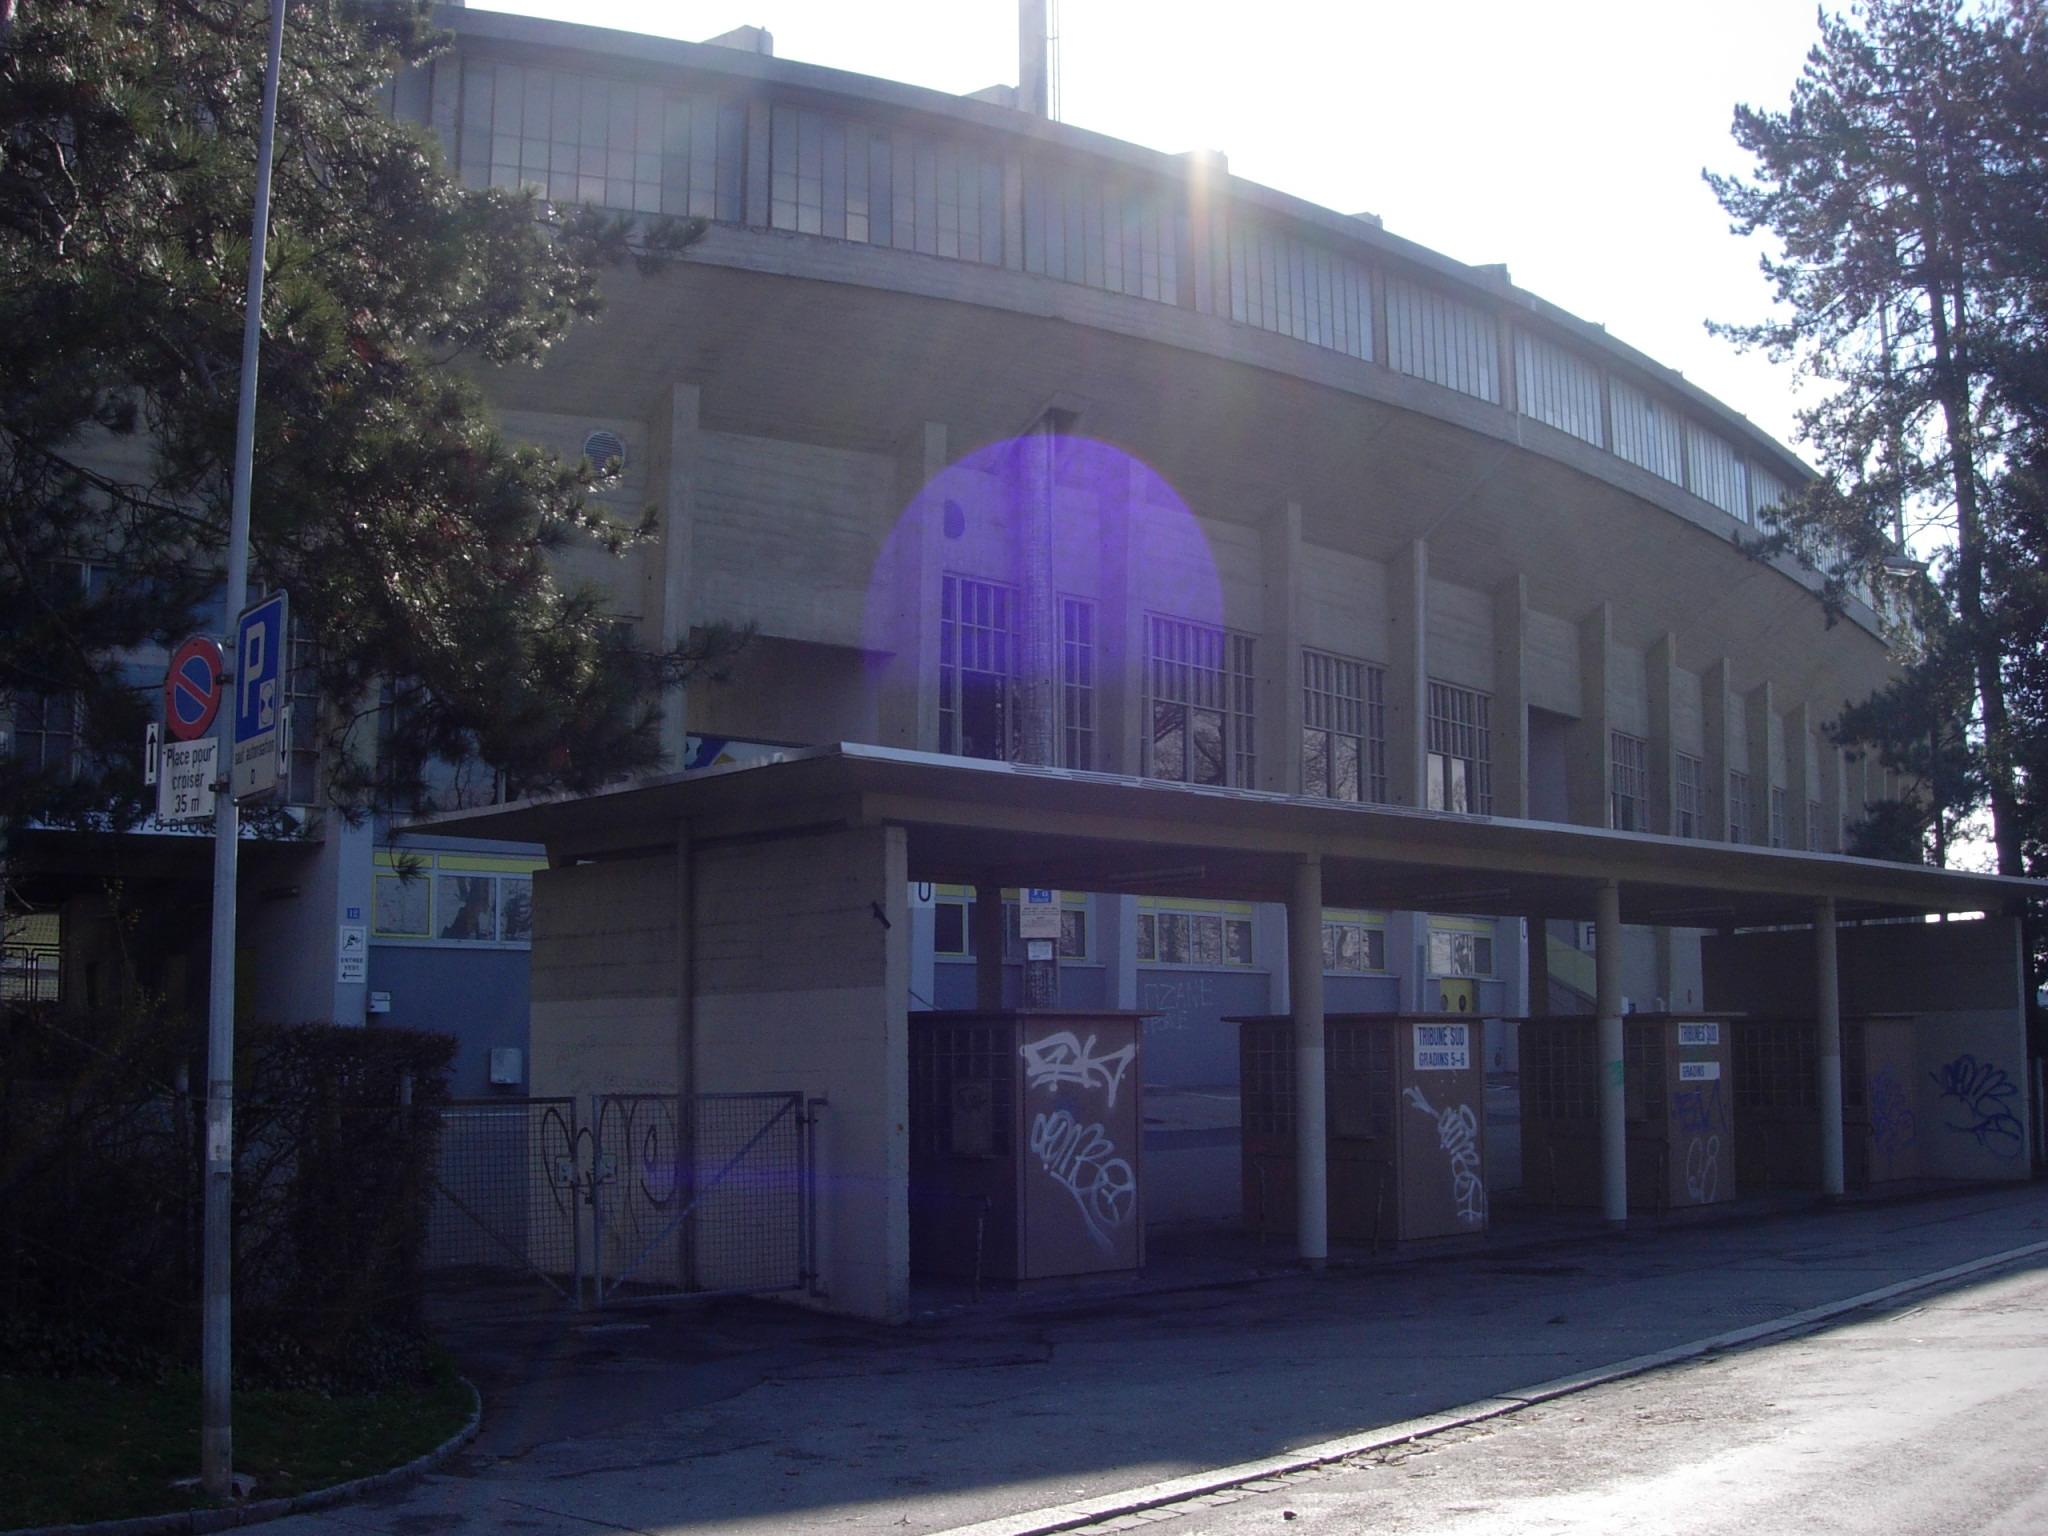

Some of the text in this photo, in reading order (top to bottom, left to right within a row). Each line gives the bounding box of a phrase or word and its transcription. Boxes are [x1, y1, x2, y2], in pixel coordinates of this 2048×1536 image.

[243, 621, 265, 718] P
[166, 747, 213, 768] Place pour
[172, 769, 205, 790] croiser
[175, 794, 200, 813] 35 m
[1418, 1026, 1465, 1046] TRIBUNE SUD
[1706, 1025, 1717, 1042] SUD
[1418, 1052, 1465, 1066] GRADINS 5-6
[1682, 1064, 1705, 1078] GRADINS
